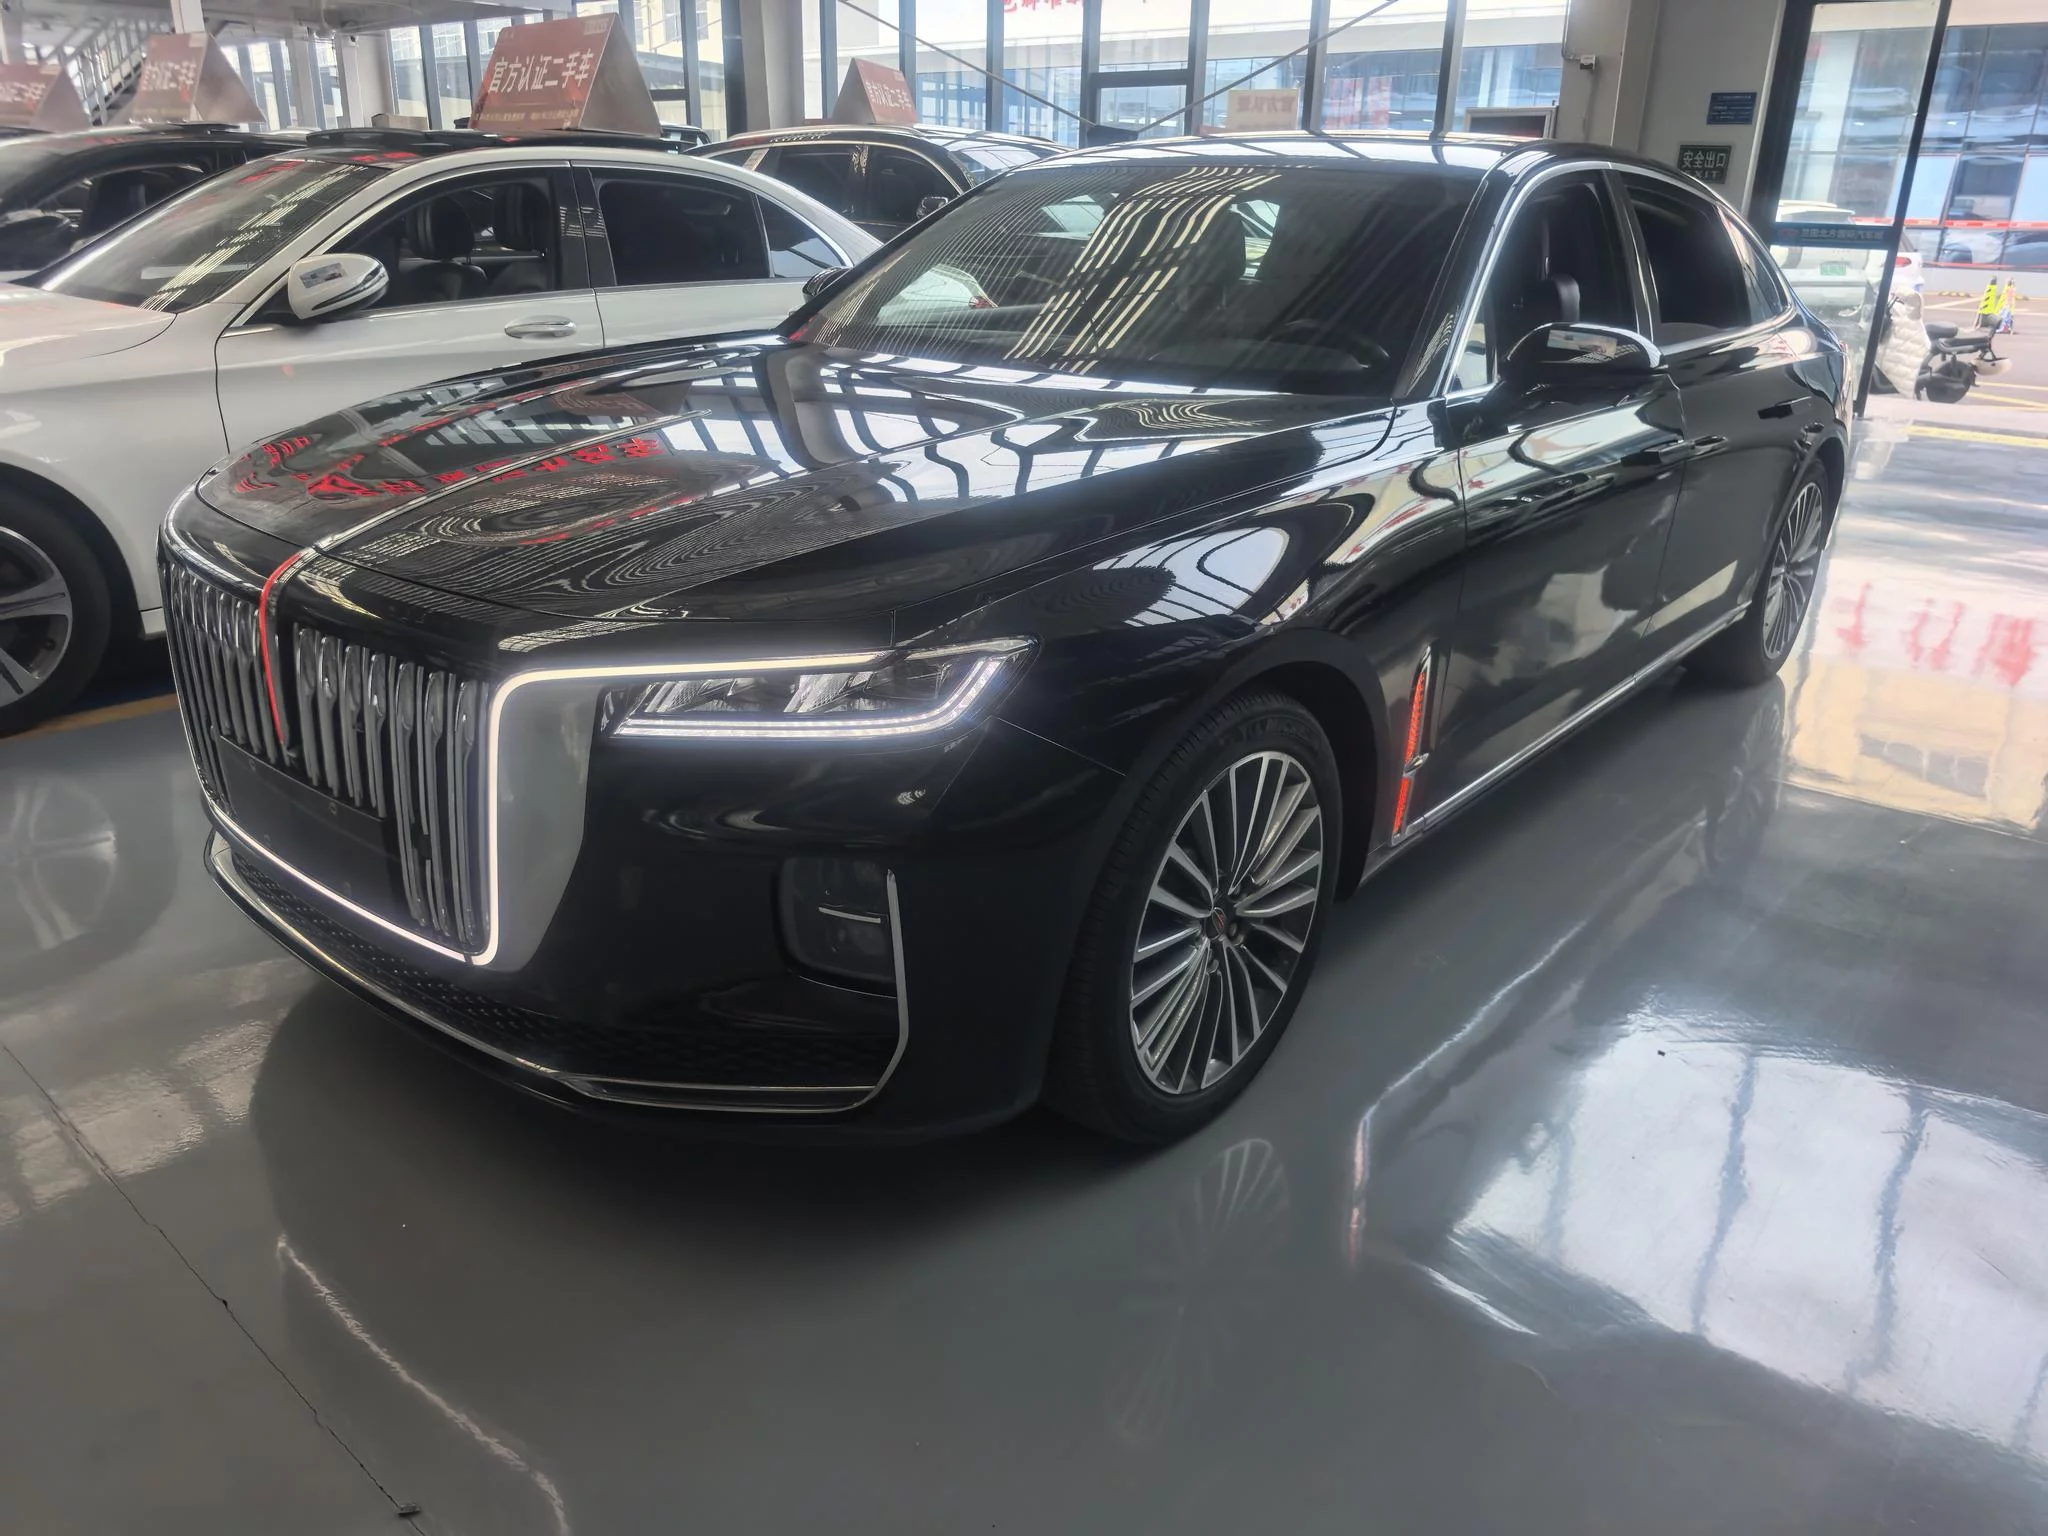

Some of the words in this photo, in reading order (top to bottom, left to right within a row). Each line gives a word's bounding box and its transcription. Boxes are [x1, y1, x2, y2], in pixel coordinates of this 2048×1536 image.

[488, 48, 595, 94] 官方认证二手车
[1683, 150, 1726, 168] 安全出口
